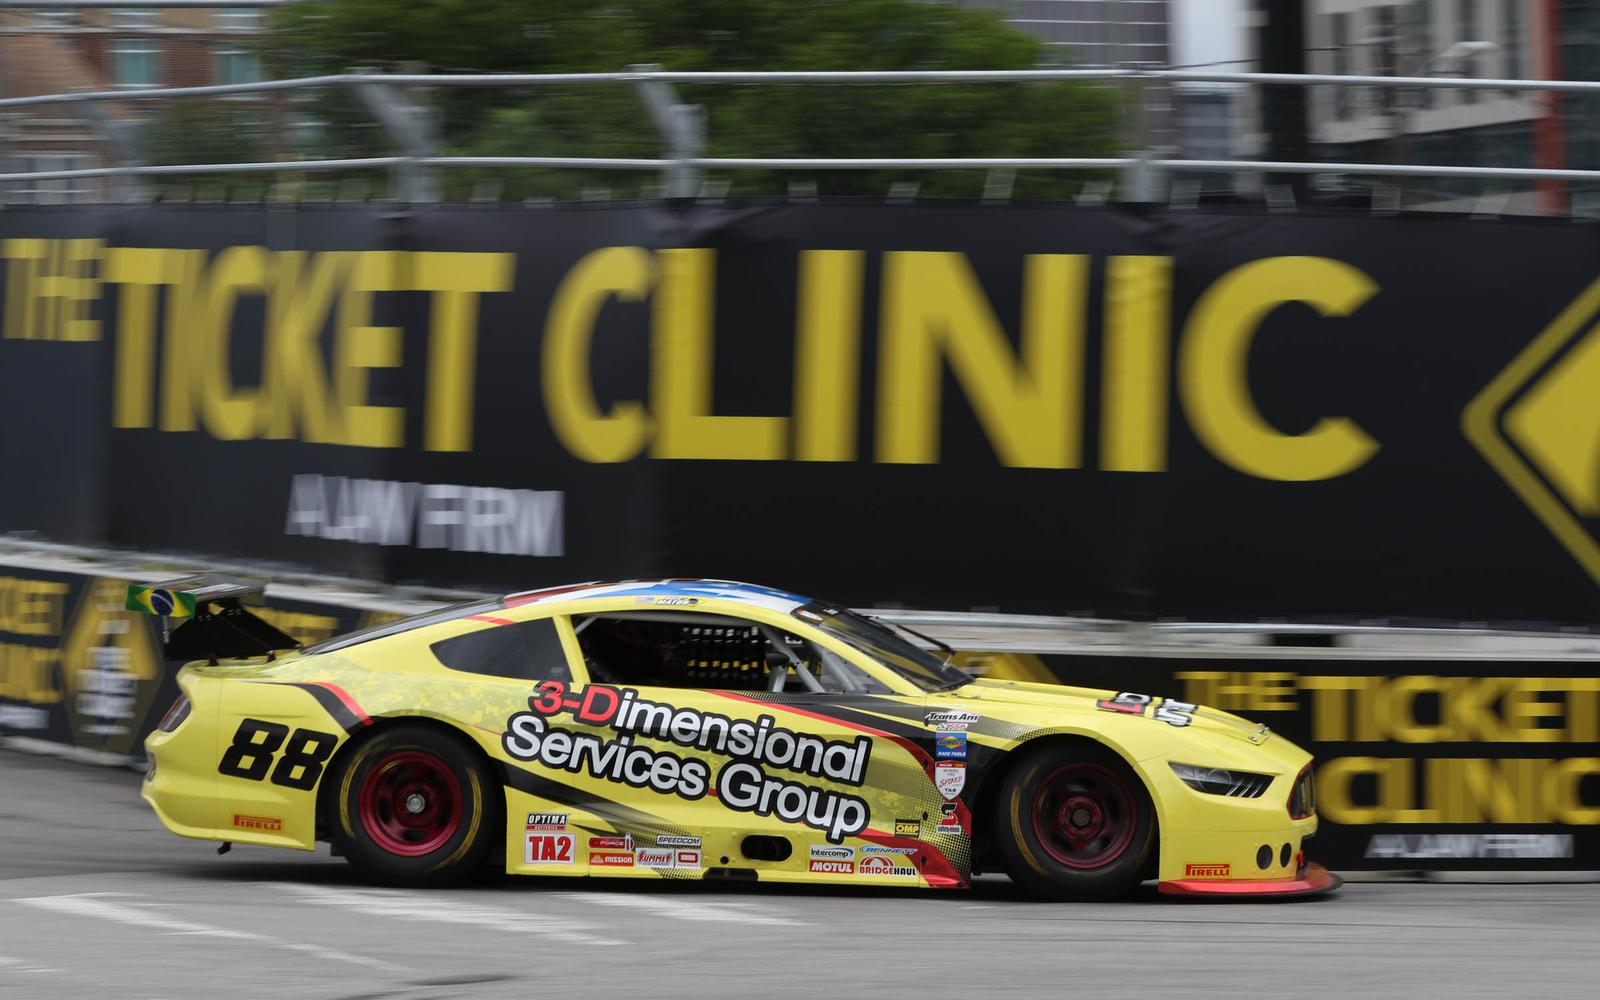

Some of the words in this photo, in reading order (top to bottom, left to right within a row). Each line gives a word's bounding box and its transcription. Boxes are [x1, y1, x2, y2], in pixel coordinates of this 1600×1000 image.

[3, 238, 103, 341] THE
[104, 245, 516, 452] TICKET
[541, 246, 1382, 481] CLINIC
[1175, 671, 1297, 711] THE
[929, 712, 958, 720] Trans
[959, 713, 978, 721] Am
[531, 680, 871, 784] 3-Dimensional
[218, 718, 339, 792] 88
[504, 713, 708, 798] Services
[719, 762, 868, 840] Group
[233, 815, 282, 831] PIRELLI
[528, 814, 566, 825] OPTIMA
[895, 824, 920, 834] OMP
[657, 835, 701, 845] SPEEDCOM
[529, 836, 572, 862] TA2
[810, 848, 850, 858] Intercomp
[604, 856, 633, 864] mission
[811, 861, 853, 873] MOTUL
[1185, 864, 1231, 876] PIRELLI
